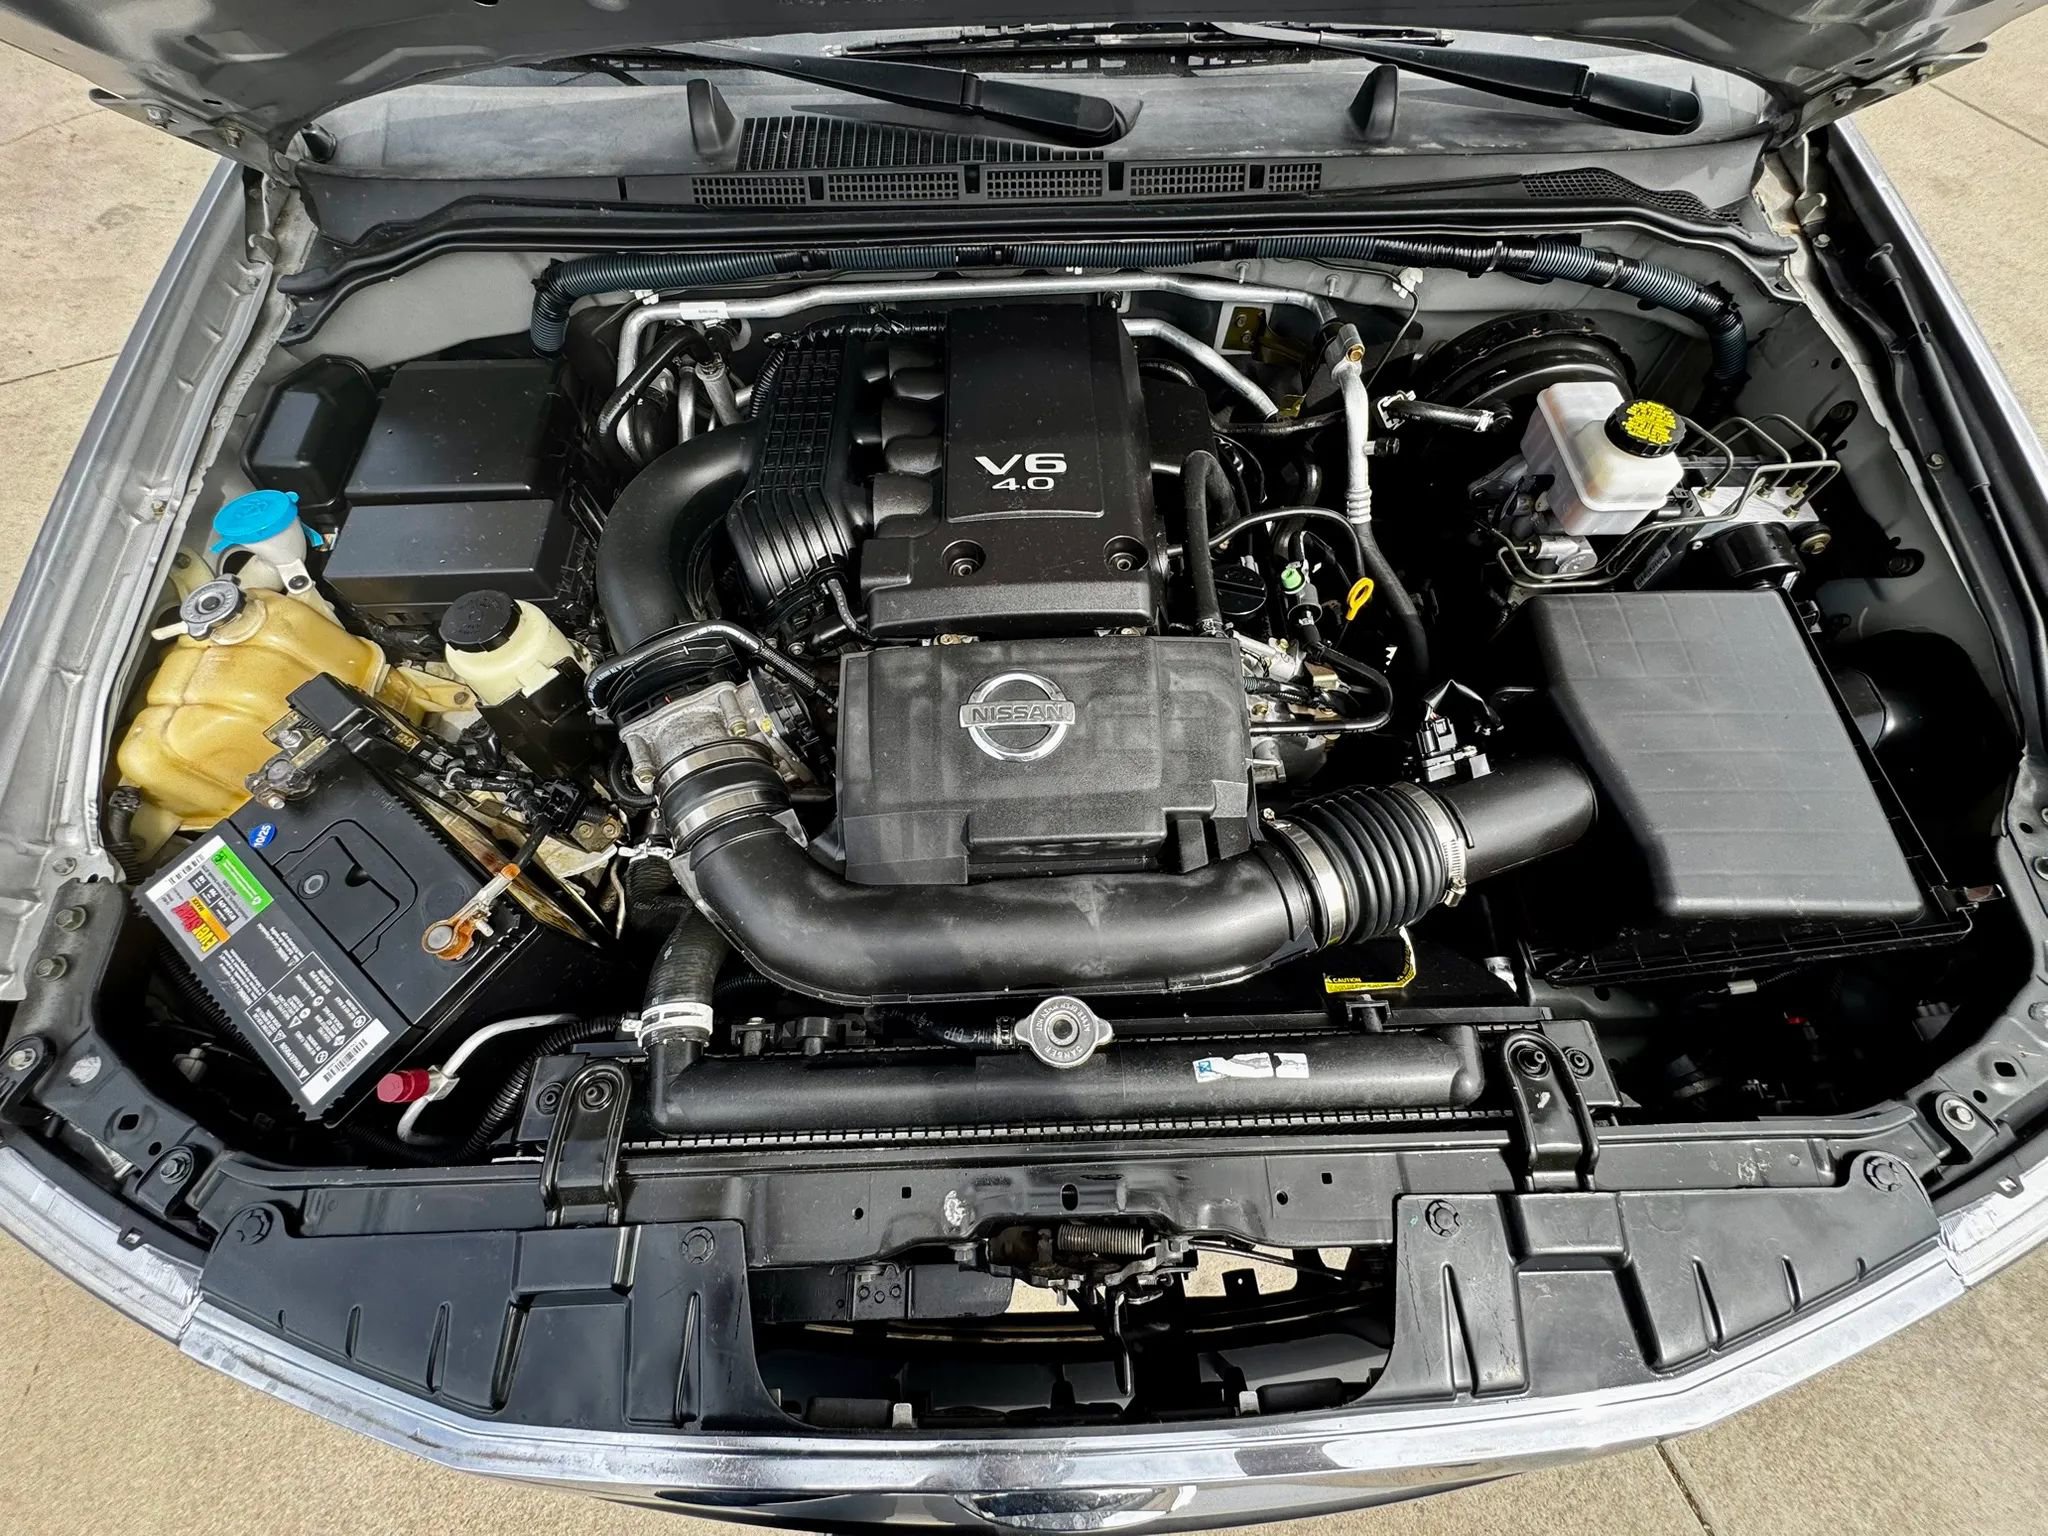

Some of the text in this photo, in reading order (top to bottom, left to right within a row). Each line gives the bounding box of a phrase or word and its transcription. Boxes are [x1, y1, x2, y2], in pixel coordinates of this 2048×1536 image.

[975, 453, 1067, 475] V6
[992, 477, 1054, 490] 4.0
[972, 704, 1064, 722] NISSAN
[253, 822, 272, 849] 10/25
[170, 899, 220, 954] EverStart
[1035, 1017, 1045, 1031] HOT
[1042, 1044, 1084, 1058] DANGER
